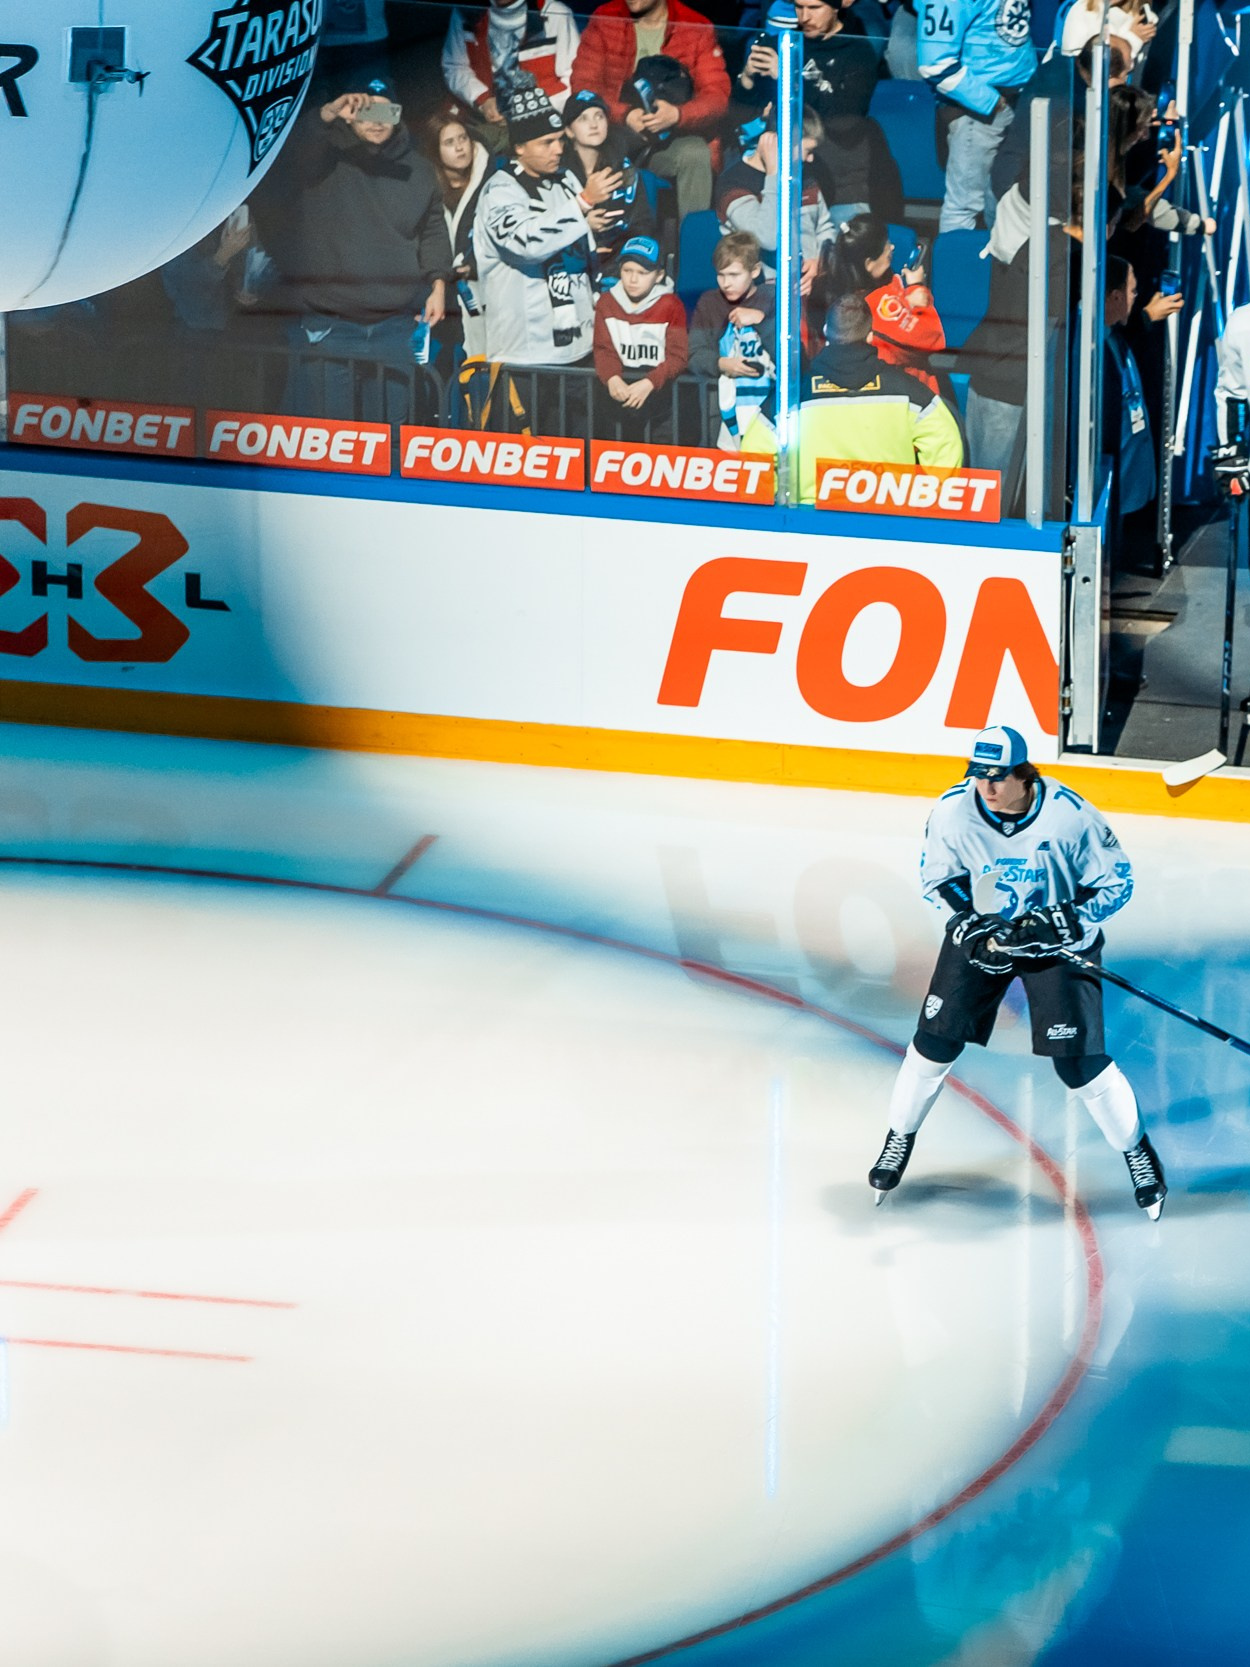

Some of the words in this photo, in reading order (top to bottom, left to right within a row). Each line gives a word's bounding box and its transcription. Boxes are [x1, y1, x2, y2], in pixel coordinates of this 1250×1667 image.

[924, 4, 954, 36] 54
[13, 404, 191, 449] FONBET
[209, 421, 387, 465] FONBET
[404, 437, 581, 481] FONBET
[594, 451, 770, 495] FONBET
[818, 468, 997, 513] FONBET
